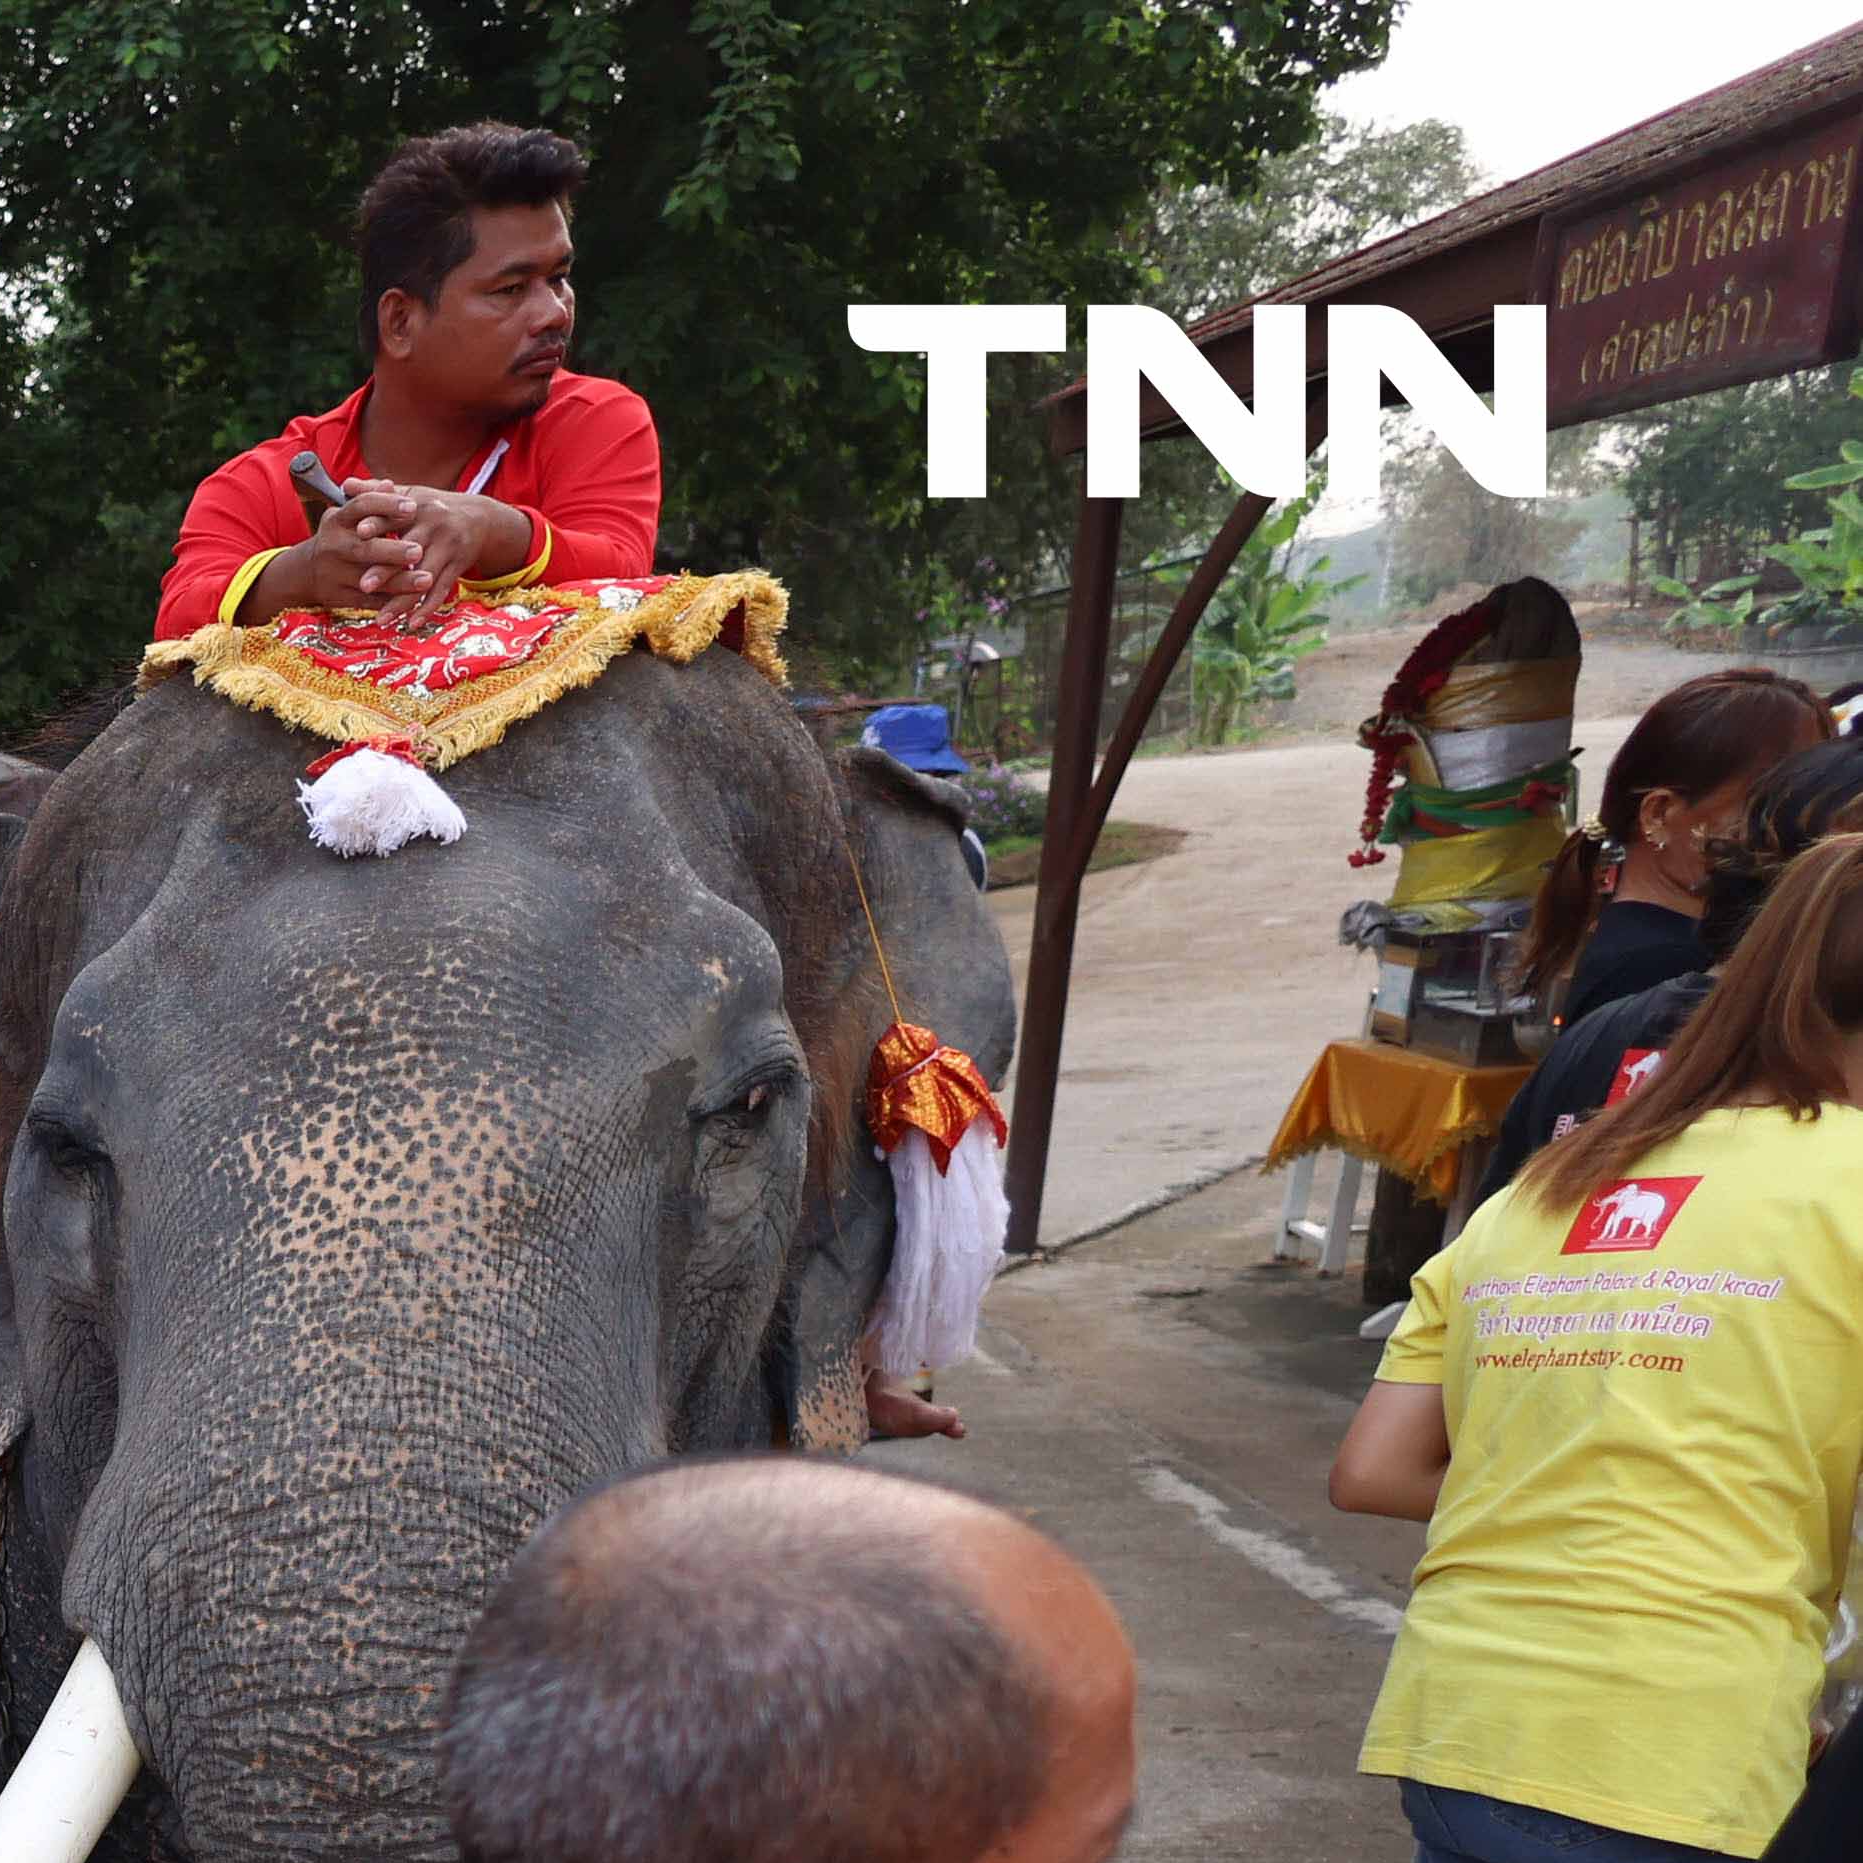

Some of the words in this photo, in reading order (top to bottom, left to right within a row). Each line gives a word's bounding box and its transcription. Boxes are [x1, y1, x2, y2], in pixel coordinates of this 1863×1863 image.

[1524, 1274, 1590, 1297] Elephant
[1642, 1269, 1659, 1289] &
[1660, 1269, 1719, 1296] Royal
[1721, 1273, 1781, 1300] kraal
